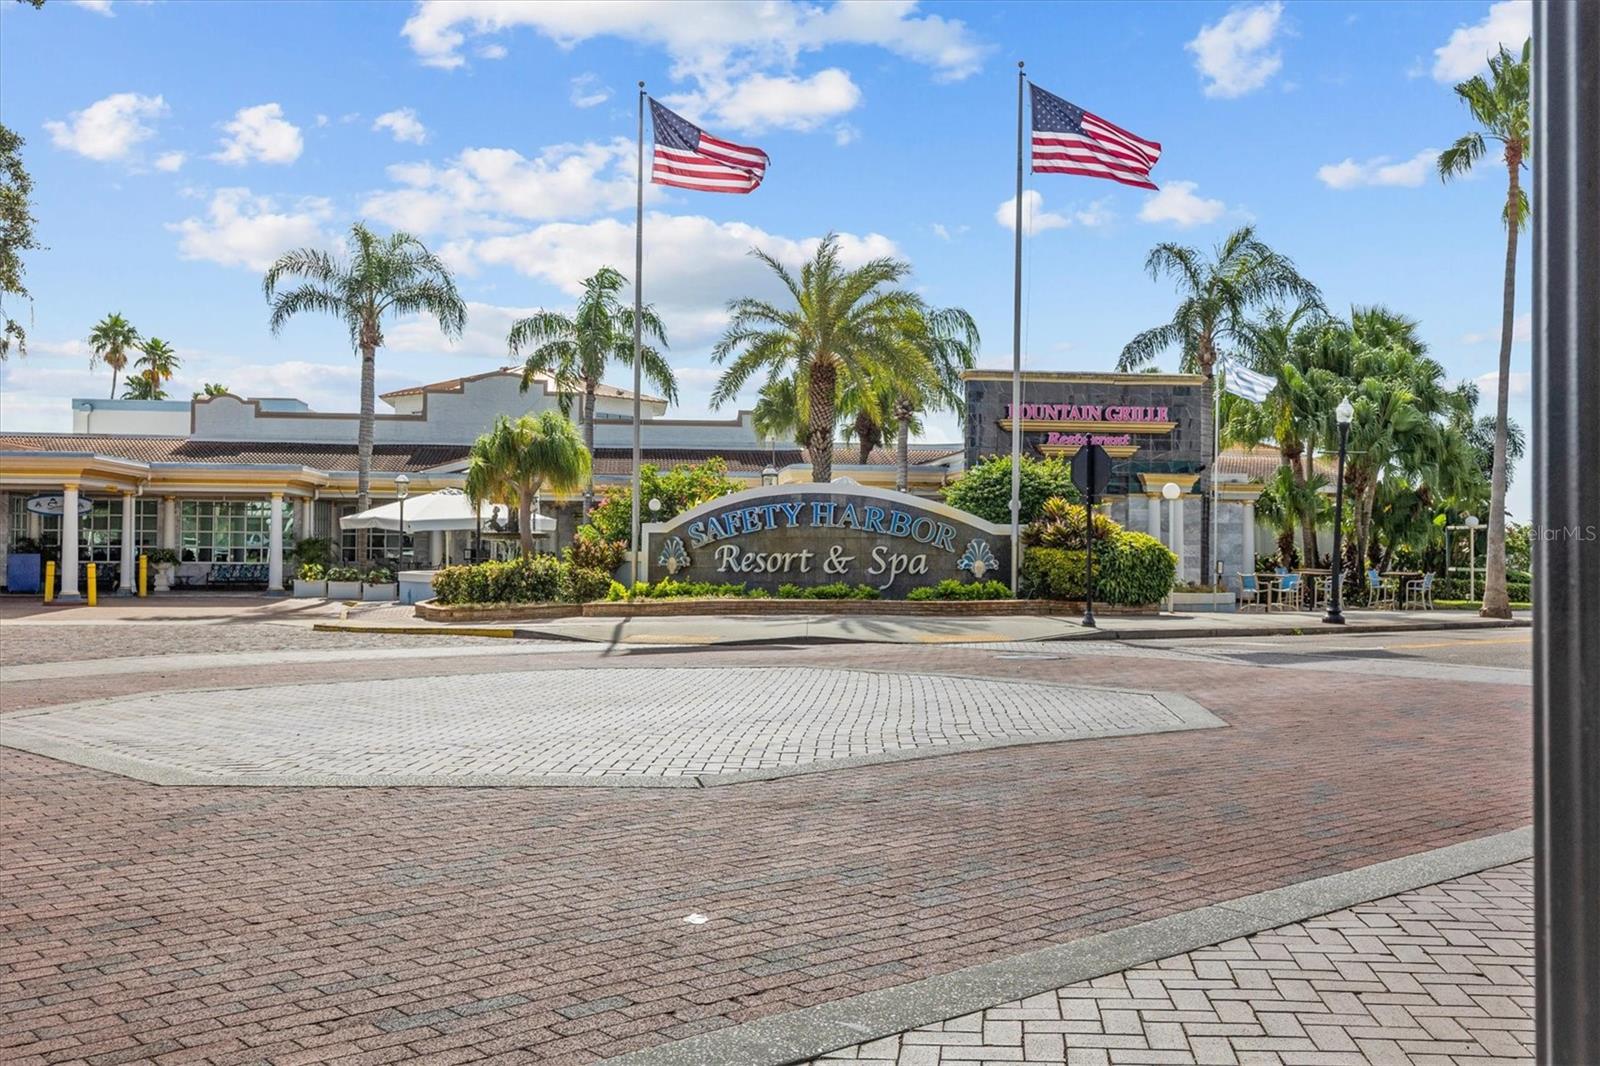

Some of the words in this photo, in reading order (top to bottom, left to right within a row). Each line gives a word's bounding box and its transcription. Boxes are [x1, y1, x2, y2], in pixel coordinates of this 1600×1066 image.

[1105, 405, 1169, 422] GRILLE
[688, 502, 806, 550] SAFETY
[810, 501, 957, 553] HARBOR
[715, 544, 815, 574] Resort
[823, 545, 856, 575] &
[868, 546, 929, 590] Spa
